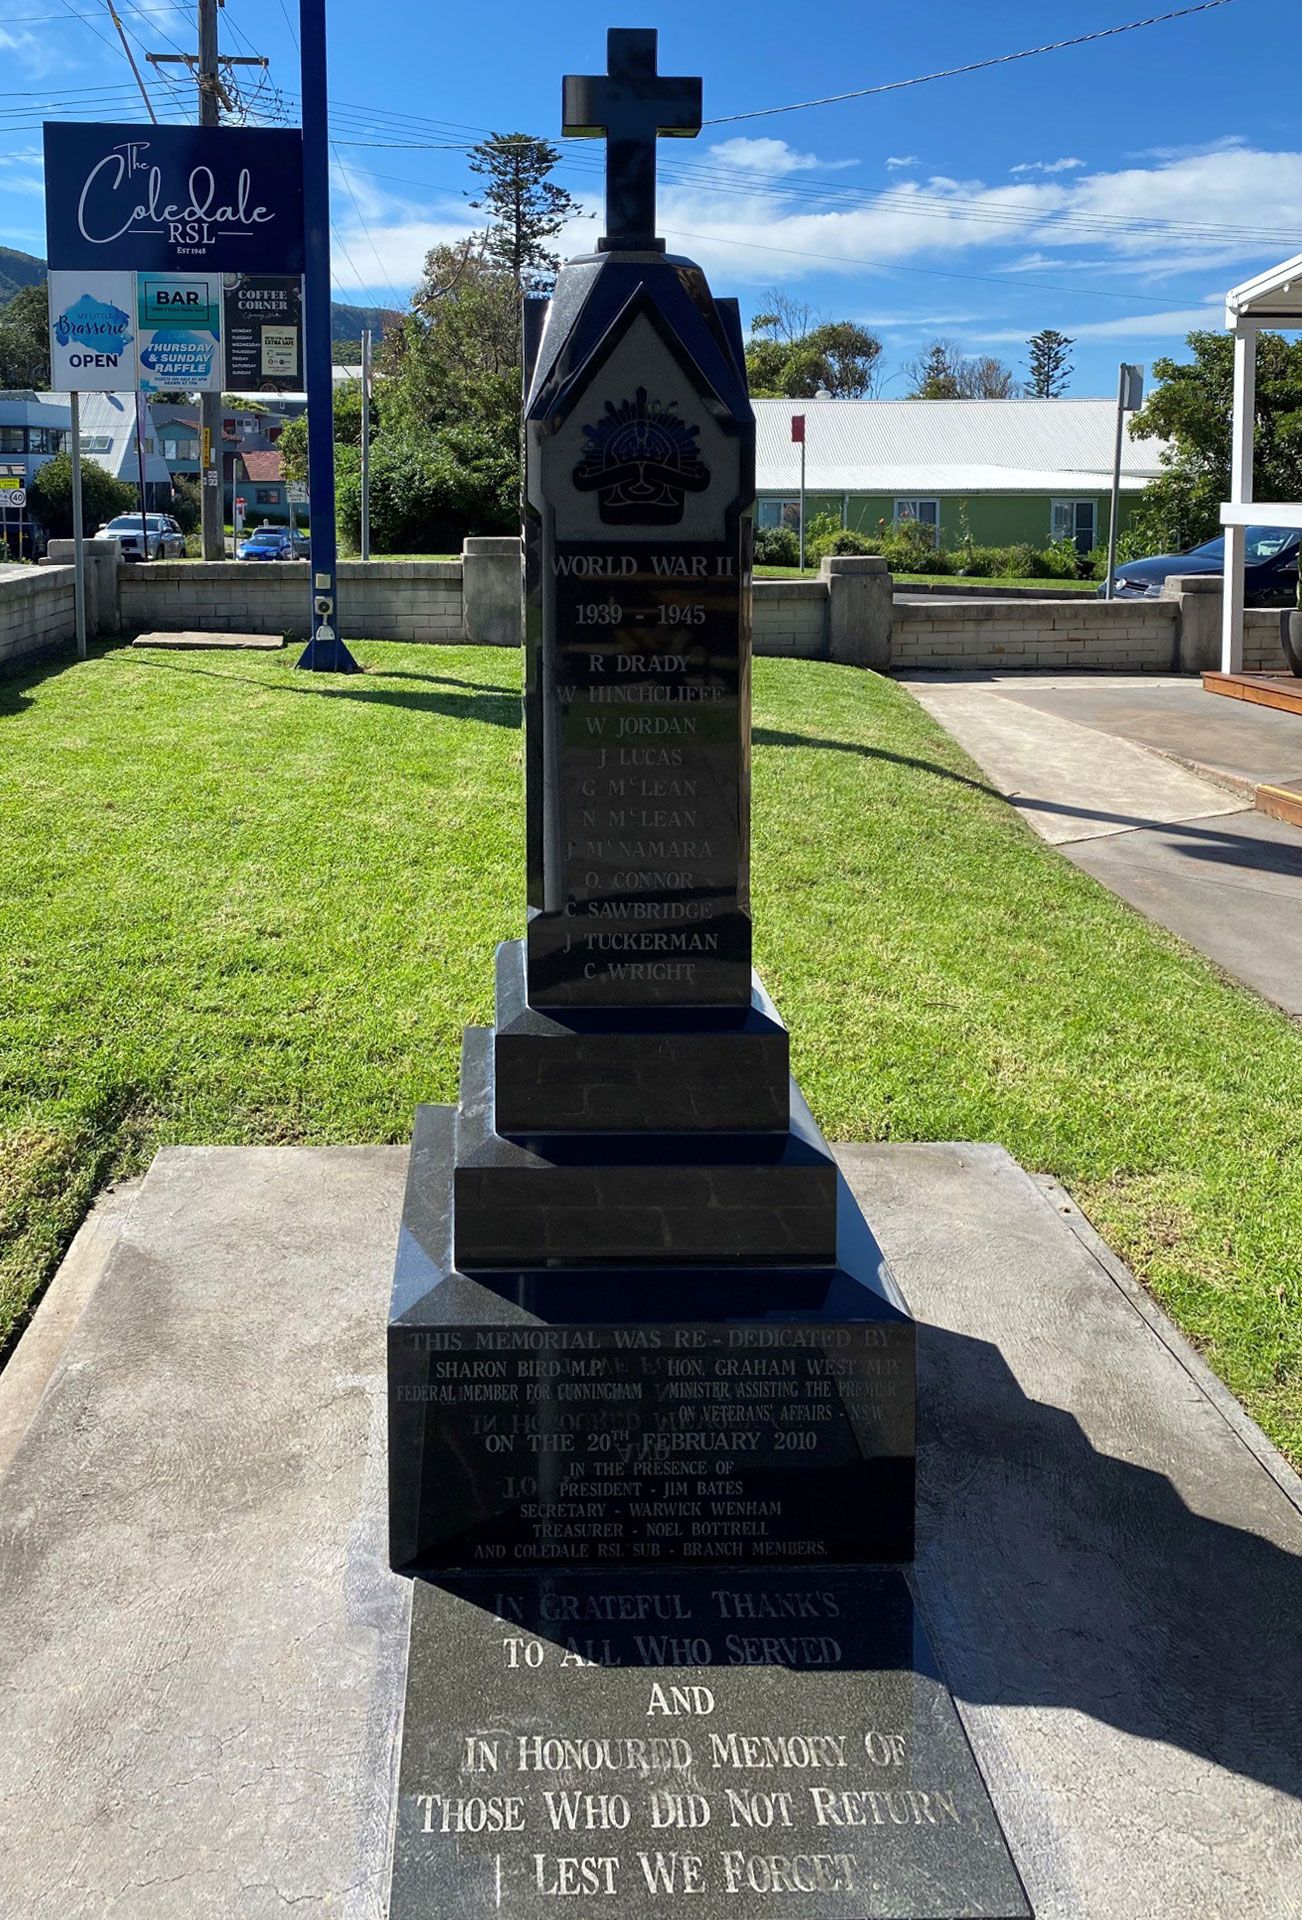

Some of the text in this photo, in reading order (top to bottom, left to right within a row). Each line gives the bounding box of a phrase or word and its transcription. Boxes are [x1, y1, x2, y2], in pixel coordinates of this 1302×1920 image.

[113, 142, 150, 178] The
[78, 154, 275, 243] Coledale
[169, 223, 215, 244] RSL
[157, 291, 199, 305] BAR
[238, 290, 287, 300] COFFEE
[238, 301, 288, 310] CORNER
[55, 314, 127, 335] Brasserie
[148, 343, 213, 352] THURSDAY
[69, 354, 118, 368] OPEN
[149, 354, 212, 363] & SUNDAY
[155, 364, 206, 373] RAFFLE
[552, 556, 734, 576] WORLD WAR II
[576, 604, 622, 624] 1939
[657, 604, 706, 624] 1945
[589, 655, 690, 672] R DRADY
[557, 685, 726, 703] W HINCHCLIFFE
[585, 717, 696, 737] W JORDAN
[598, 749, 683, 769] J LUCAS
[582, 779, 596, 796] G
[582, 810, 595, 827] N
[614, 871, 695, 889] CONNOR
[566, 902, 713, 919] C SAWBRIDGE
[563, 933, 719, 953] J TUCKERMAN
[584, 962, 695, 981] C WRIGHT
[409, 1332, 463, 1351] THIS
[476, 1331, 601, 1350] MEMORIAL
[613, 1330, 662, 1349] WAS
[727, 1329, 851, 1348] DEDICATED
[864, 1328, 893, 1347] BY
[436, 1361, 507, 1378] SHARON
[517, 1361, 561, 1378] BIRD
[667, 1360, 705, 1377] HON.
[715, 1359, 796, 1376] GRAHAM
[806, 1359, 857, 1376] WEST
[398, 1383, 643, 1402] FEDERAL MEMBER FOR CUNNINGHAM
[669, 1382, 729, 1399] MINISTER
[737, 1381, 799, 1399] ASSISTING
[805, 1381, 832, 1398] THE
[678, 1405, 696, 1422] ON
[780, 1404, 832, 1421] AFFAIRS
[485, 1434, 514, 1452] ON
[527, 1434, 575, 1451] THE
[642, 1432, 761, 1451] FEBRUARY
[774, 1431, 817, 1450] 2010
[570, 1461, 735, 1476] IN THE PRESENCE OF
[560, 1482, 643, 1497] PRESIDENT
[663, 1481, 688, 1498] JIM
[697, 1481, 743, 1496] BATES
[520, 1503, 607, 1519] SECRETARY
[629, 1502, 702, 1517] WARWICK
[711, 1501, 781, 1516] WENHAM
[533, 1524, 624, 1538] TREASURER
[646, 1522, 684, 1536] NOEL
[692, 1522, 768, 1536] BOTTRELL
[474, 1545, 506, 1559] AND
[514, 1544, 590, 1559] COLEDALE
[598, 1544, 625, 1558] RSL
[633, 1543, 660, 1557] SUB
[683, 1542, 743, 1556] BRANCH
[540, 1593, 692, 1619] GRATEFUL
[725, 1634, 842, 1665] SERVED
[709, 1733, 847, 1768] MEMORY
[417, 1794, 525, 1833] THOSE
[542, 1791, 631, 1830] WHO
[725, 1789, 793, 1828] NOT
[533, 1854, 620, 1896] LEST
[637, 1852, 706, 1894] WE
